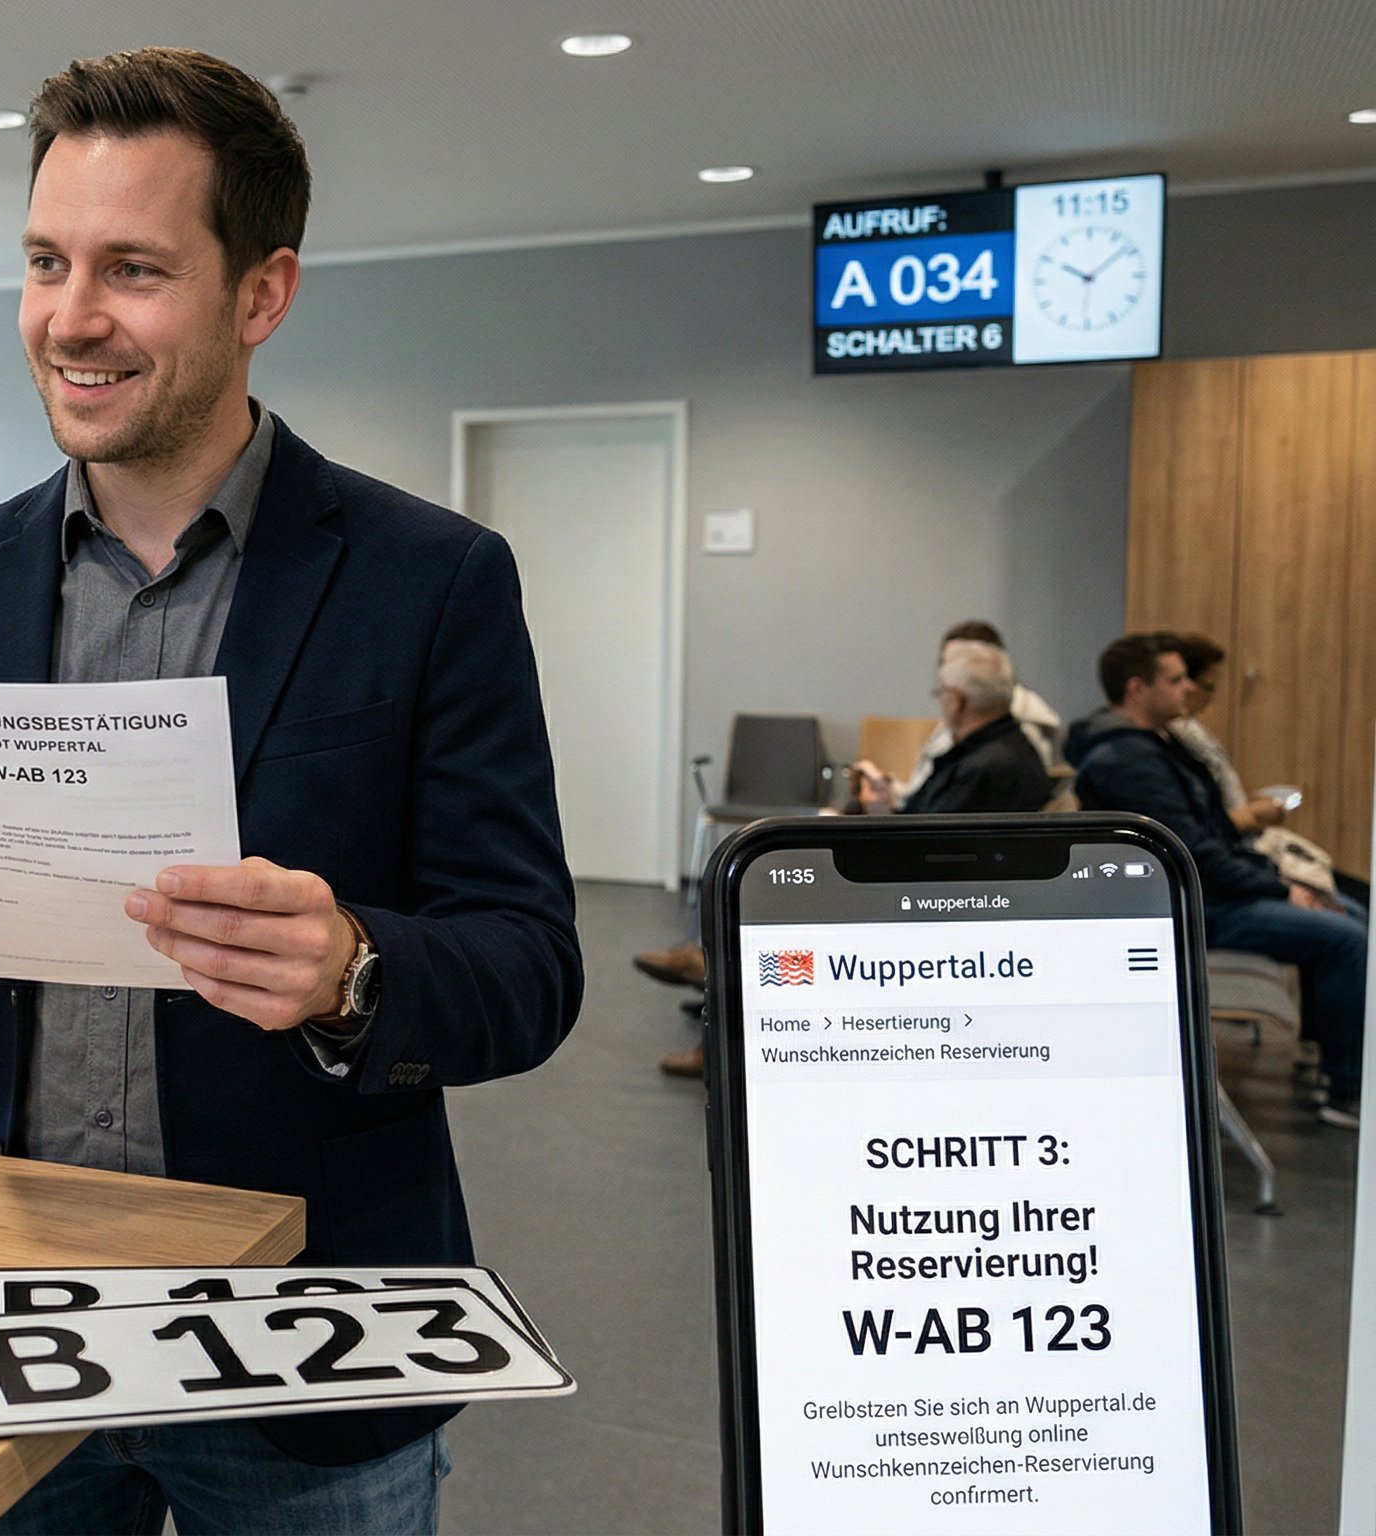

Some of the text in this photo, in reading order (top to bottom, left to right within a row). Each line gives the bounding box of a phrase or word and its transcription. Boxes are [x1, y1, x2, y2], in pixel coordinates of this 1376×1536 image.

[1055, 189, 1128, 215] 11:15
[824, 206, 945, 238] AUFRUF:
[832, 250, 997, 308] A 034
[827, 324, 1002, 357] SCHALTER 6
[14, 740, 106, 752] WUPPERTAL
[52, 769, 87, 784] 123
[769, 869, 814, 884] 11:35
[917, 895, 1009, 912] wuppertal.de
[829, 951, 1033, 987] Wuppertal.de
[761, 1015, 950, 1033] Home Hesertierung
[762, 1045, 1050, 1062] Wunschkennzeichen Reservierung
[867, 1135, 1069, 1168] SCHRITT 3:
[851, 1200, 1095, 1241] Nutzung Ihrer
[852, 1245, 1097, 1283] Reservierung!
[843, 1304, 1111, 1355] W-AB 123
[153, 1299, 512, 1393] 123
[804, 1393, 1155, 1419] Grelbstzen Sie sich an Wuppertal.de
[1029, 1424, 1088, 1443] online
[811, 1453, 1154, 1479] Wunschkennzeichen-Reservierung
[931, 1485, 1038, 1505] confirmert.
